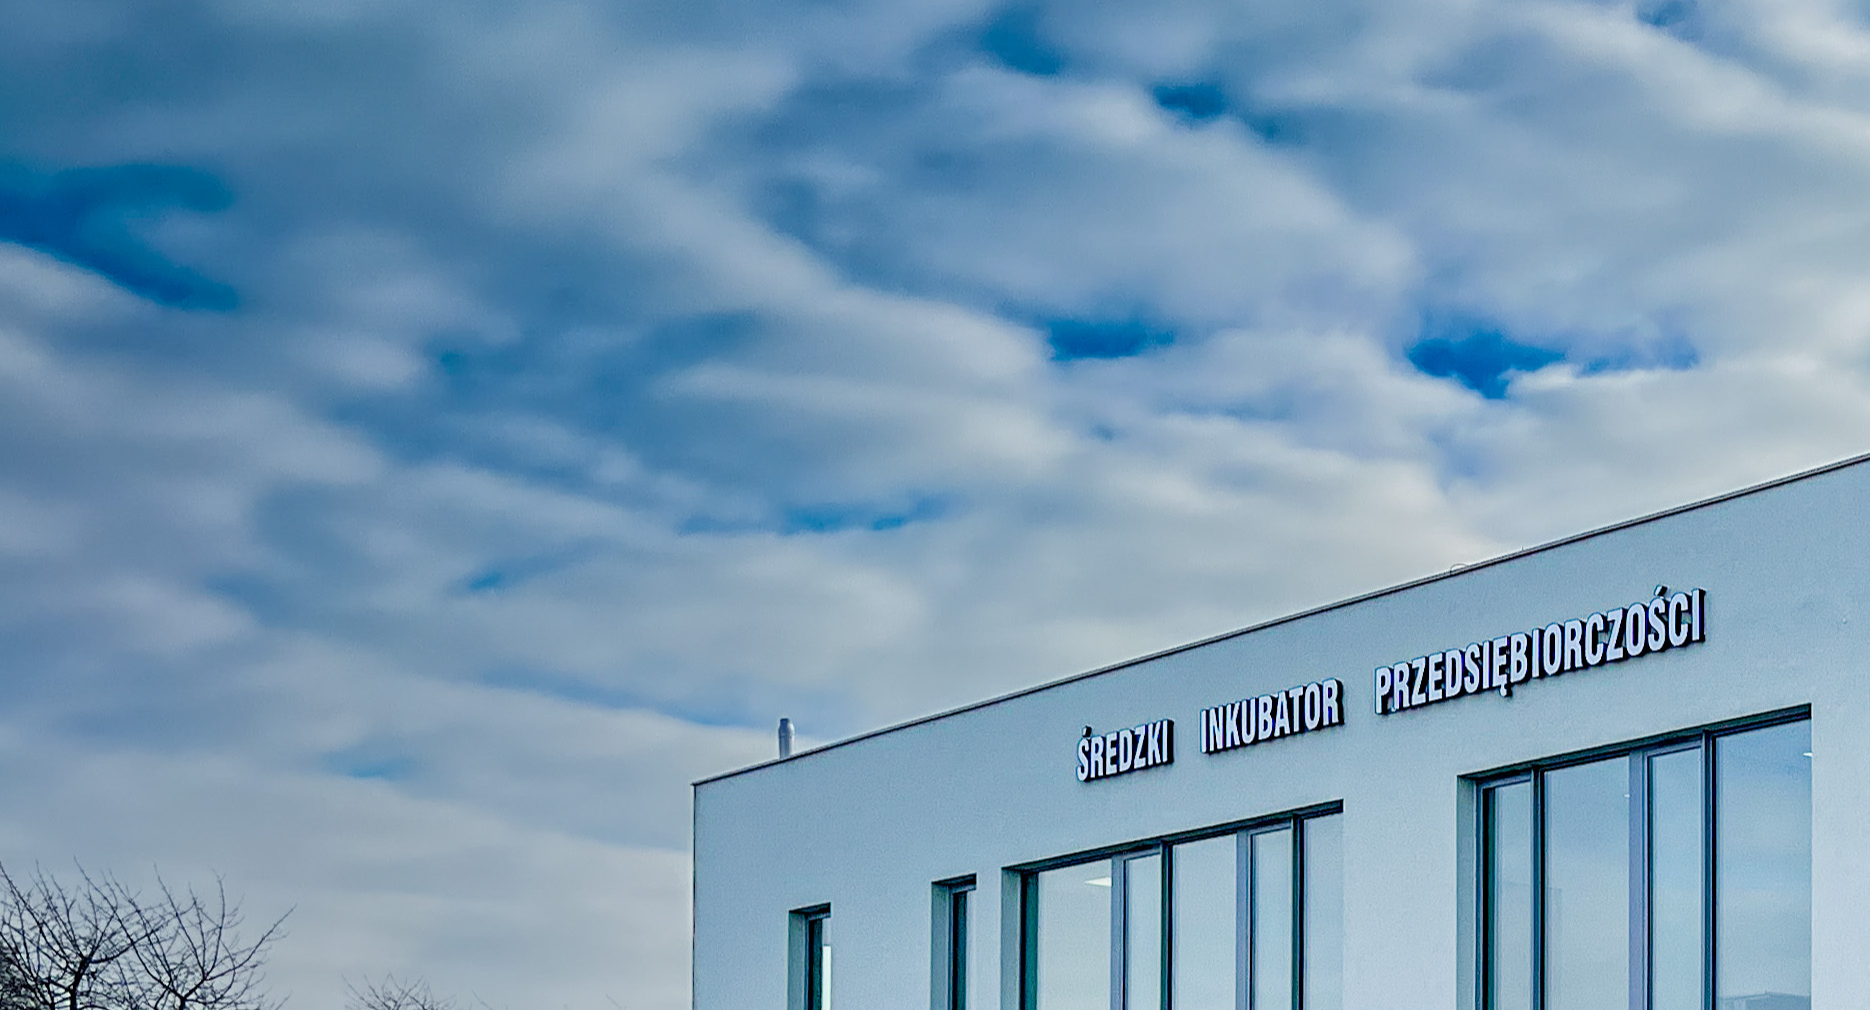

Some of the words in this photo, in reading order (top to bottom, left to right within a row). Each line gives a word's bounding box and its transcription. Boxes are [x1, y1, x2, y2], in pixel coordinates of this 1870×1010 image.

[1076, 719, 1174, 782] ŚREDZKI
[1200, 678, 1344, 754] INKUBATOR
[1375, 585, 1706, 715] PRZEDSIĘBIORCZOŚCI
